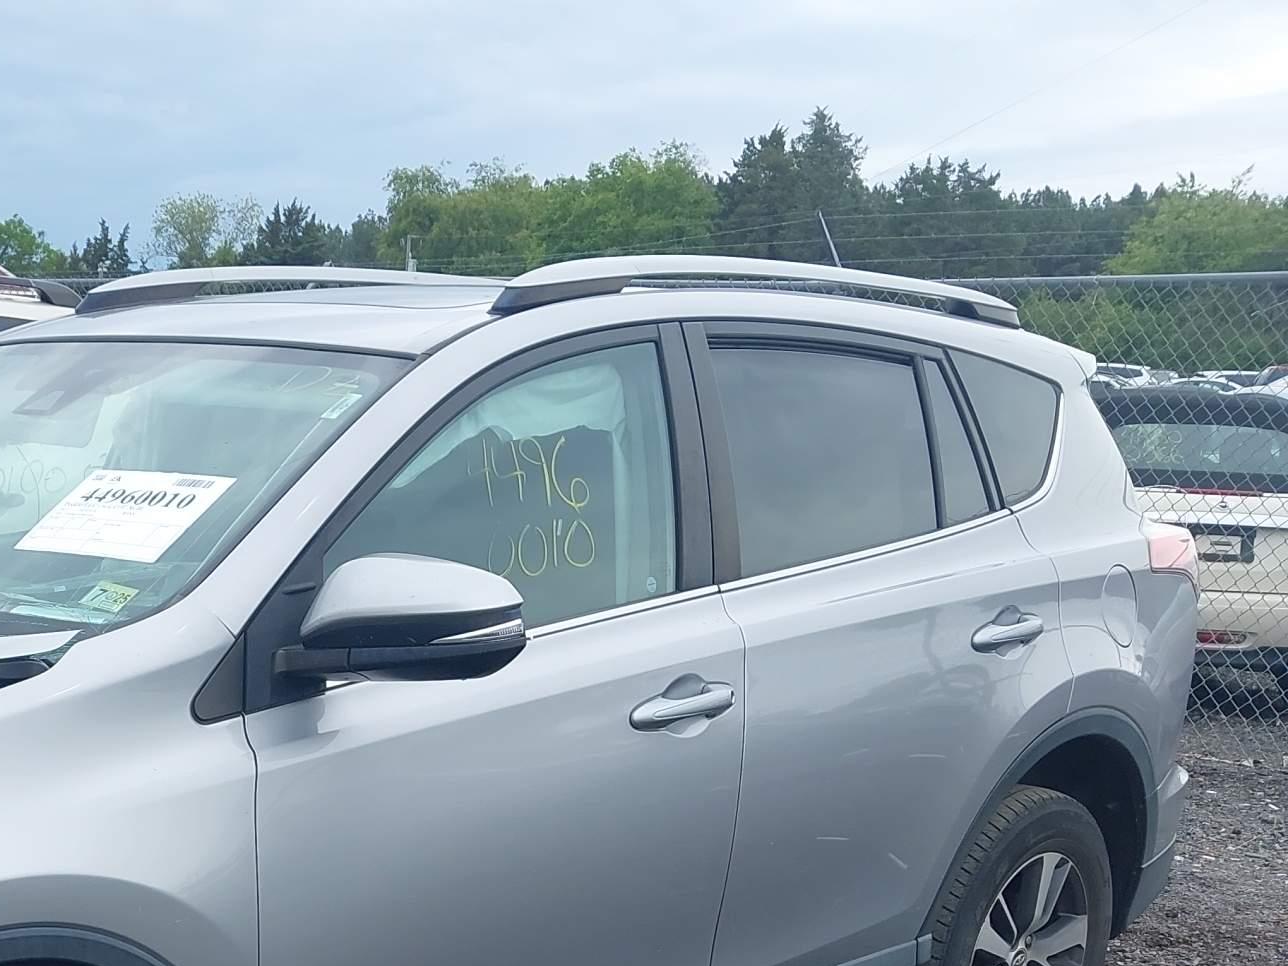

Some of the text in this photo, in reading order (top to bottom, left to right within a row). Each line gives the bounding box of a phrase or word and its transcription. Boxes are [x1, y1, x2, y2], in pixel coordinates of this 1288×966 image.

[467, 435, 590, 514] 4496
[80, 487, 197, 510] 44960010
[90, 588, 109, 601] 7
